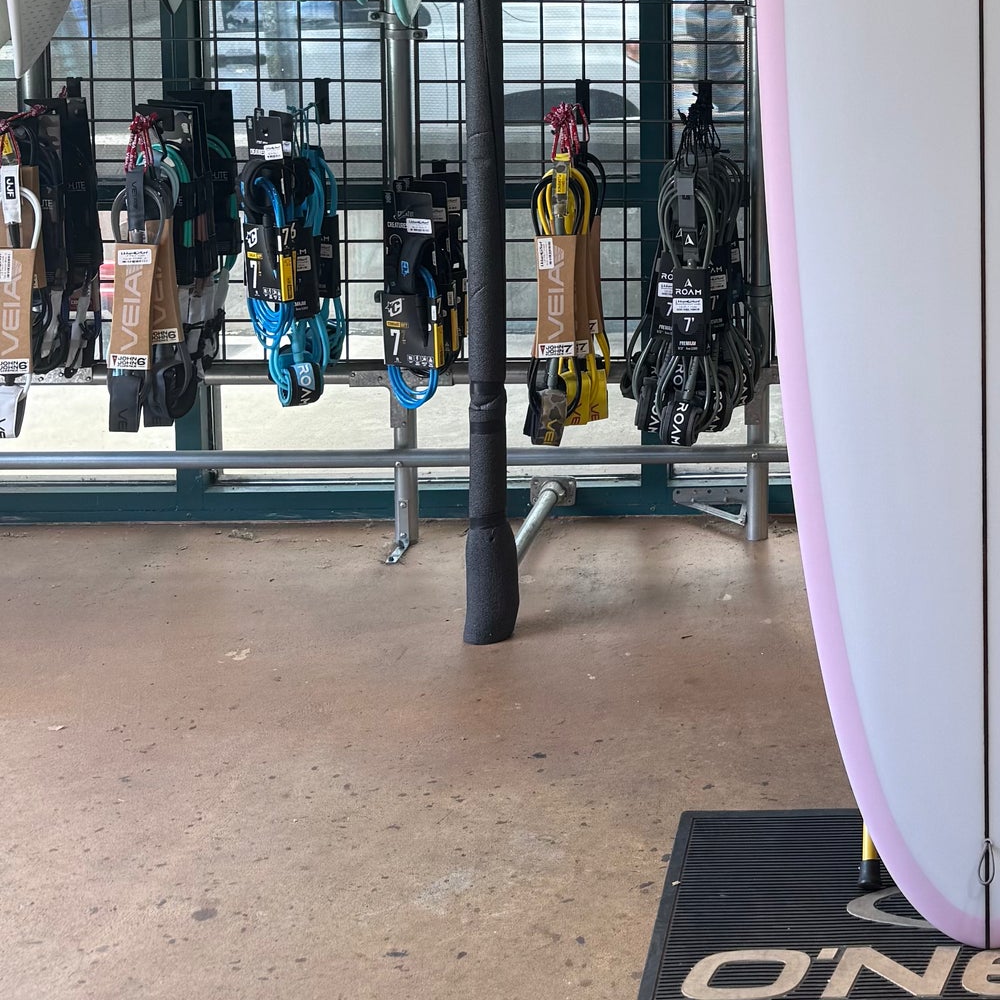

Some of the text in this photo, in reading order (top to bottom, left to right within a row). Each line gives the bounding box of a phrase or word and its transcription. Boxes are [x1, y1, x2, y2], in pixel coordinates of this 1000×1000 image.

[6, 178, 14, 198] JJF
[548, 246, 565, 340] VEIA
[390, 329, 400, 356] 7
[671, 402, 688, 444] ROAM
